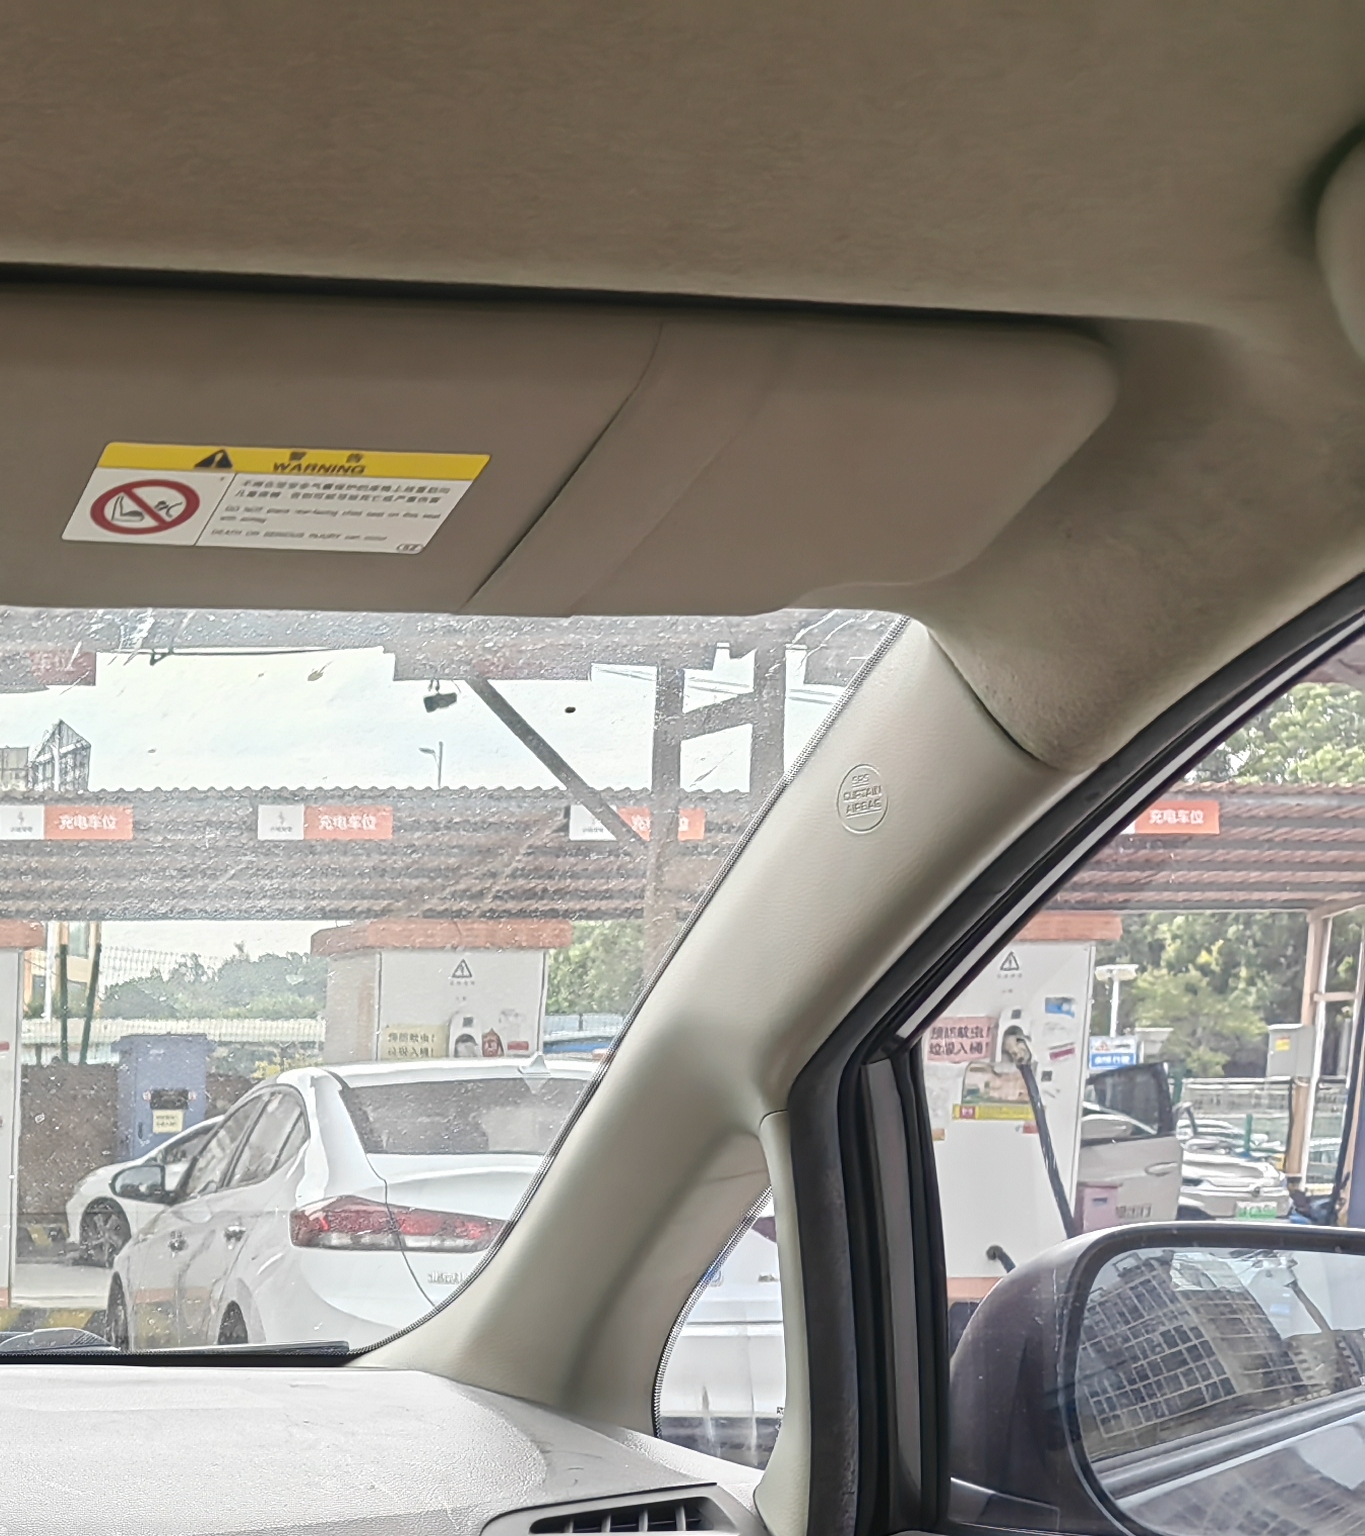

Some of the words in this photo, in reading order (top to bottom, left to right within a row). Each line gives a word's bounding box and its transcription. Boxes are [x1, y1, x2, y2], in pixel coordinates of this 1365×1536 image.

[273, 463, 365, 474] WARNING
[59, 814, 117, 831] 充电车位
[320, 814, 377, 830] 充电车位
[1149, 808, 1204, 824] 充电车位
